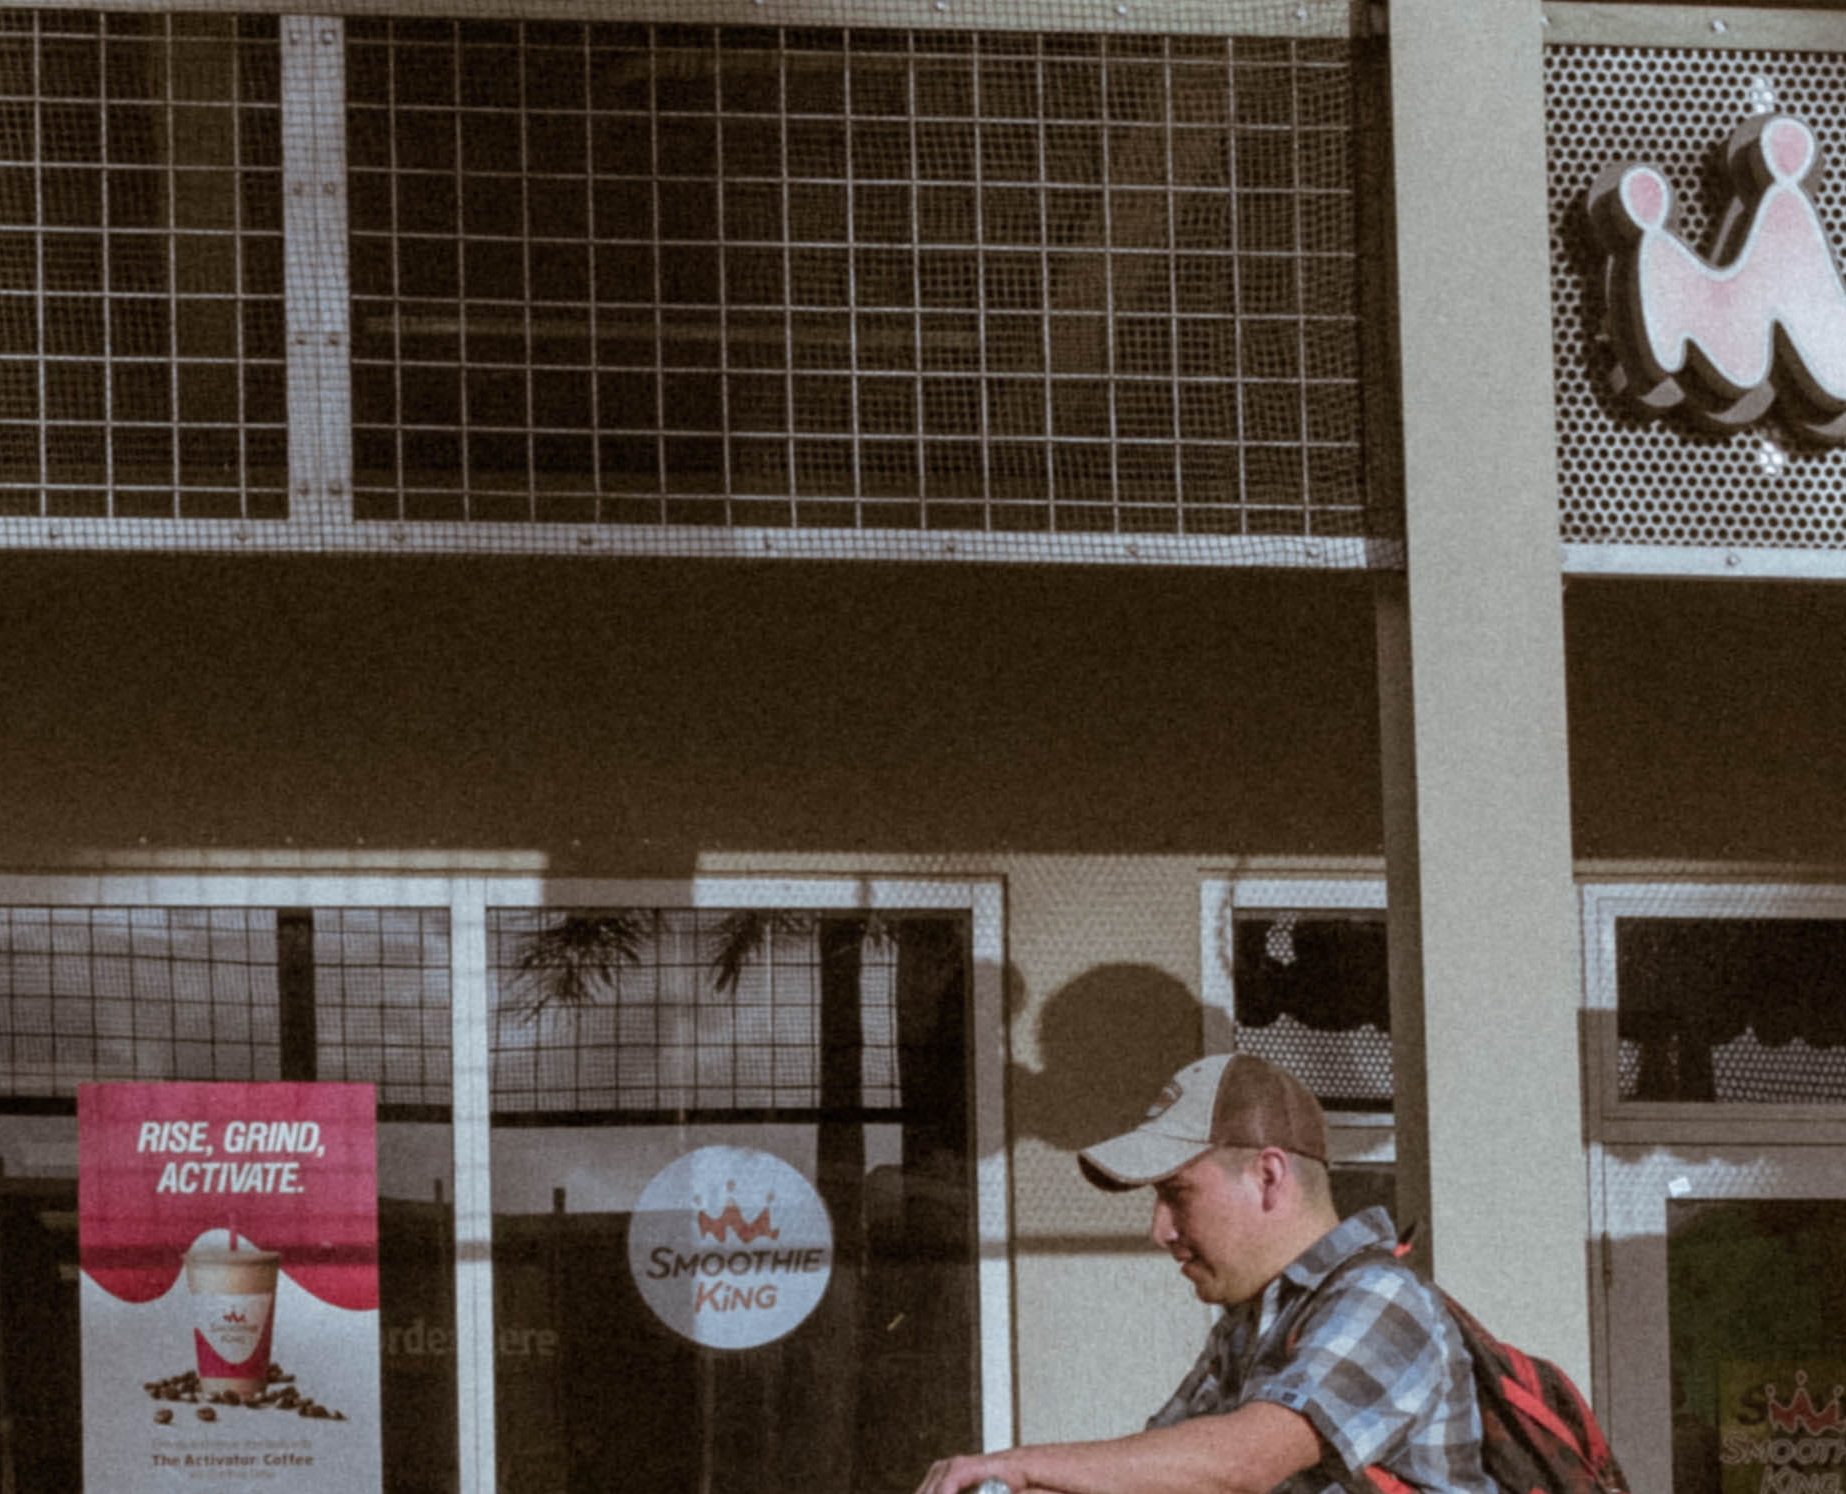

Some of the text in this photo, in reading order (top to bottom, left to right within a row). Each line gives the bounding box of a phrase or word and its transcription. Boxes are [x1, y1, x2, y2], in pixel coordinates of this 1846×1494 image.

[137, 1121, 326, 1157] RISE, GRIND,
[156, 1161, 305, 1194] ACTIVATE.
[645, 1246, 824, 1280] SMOOTHIE
